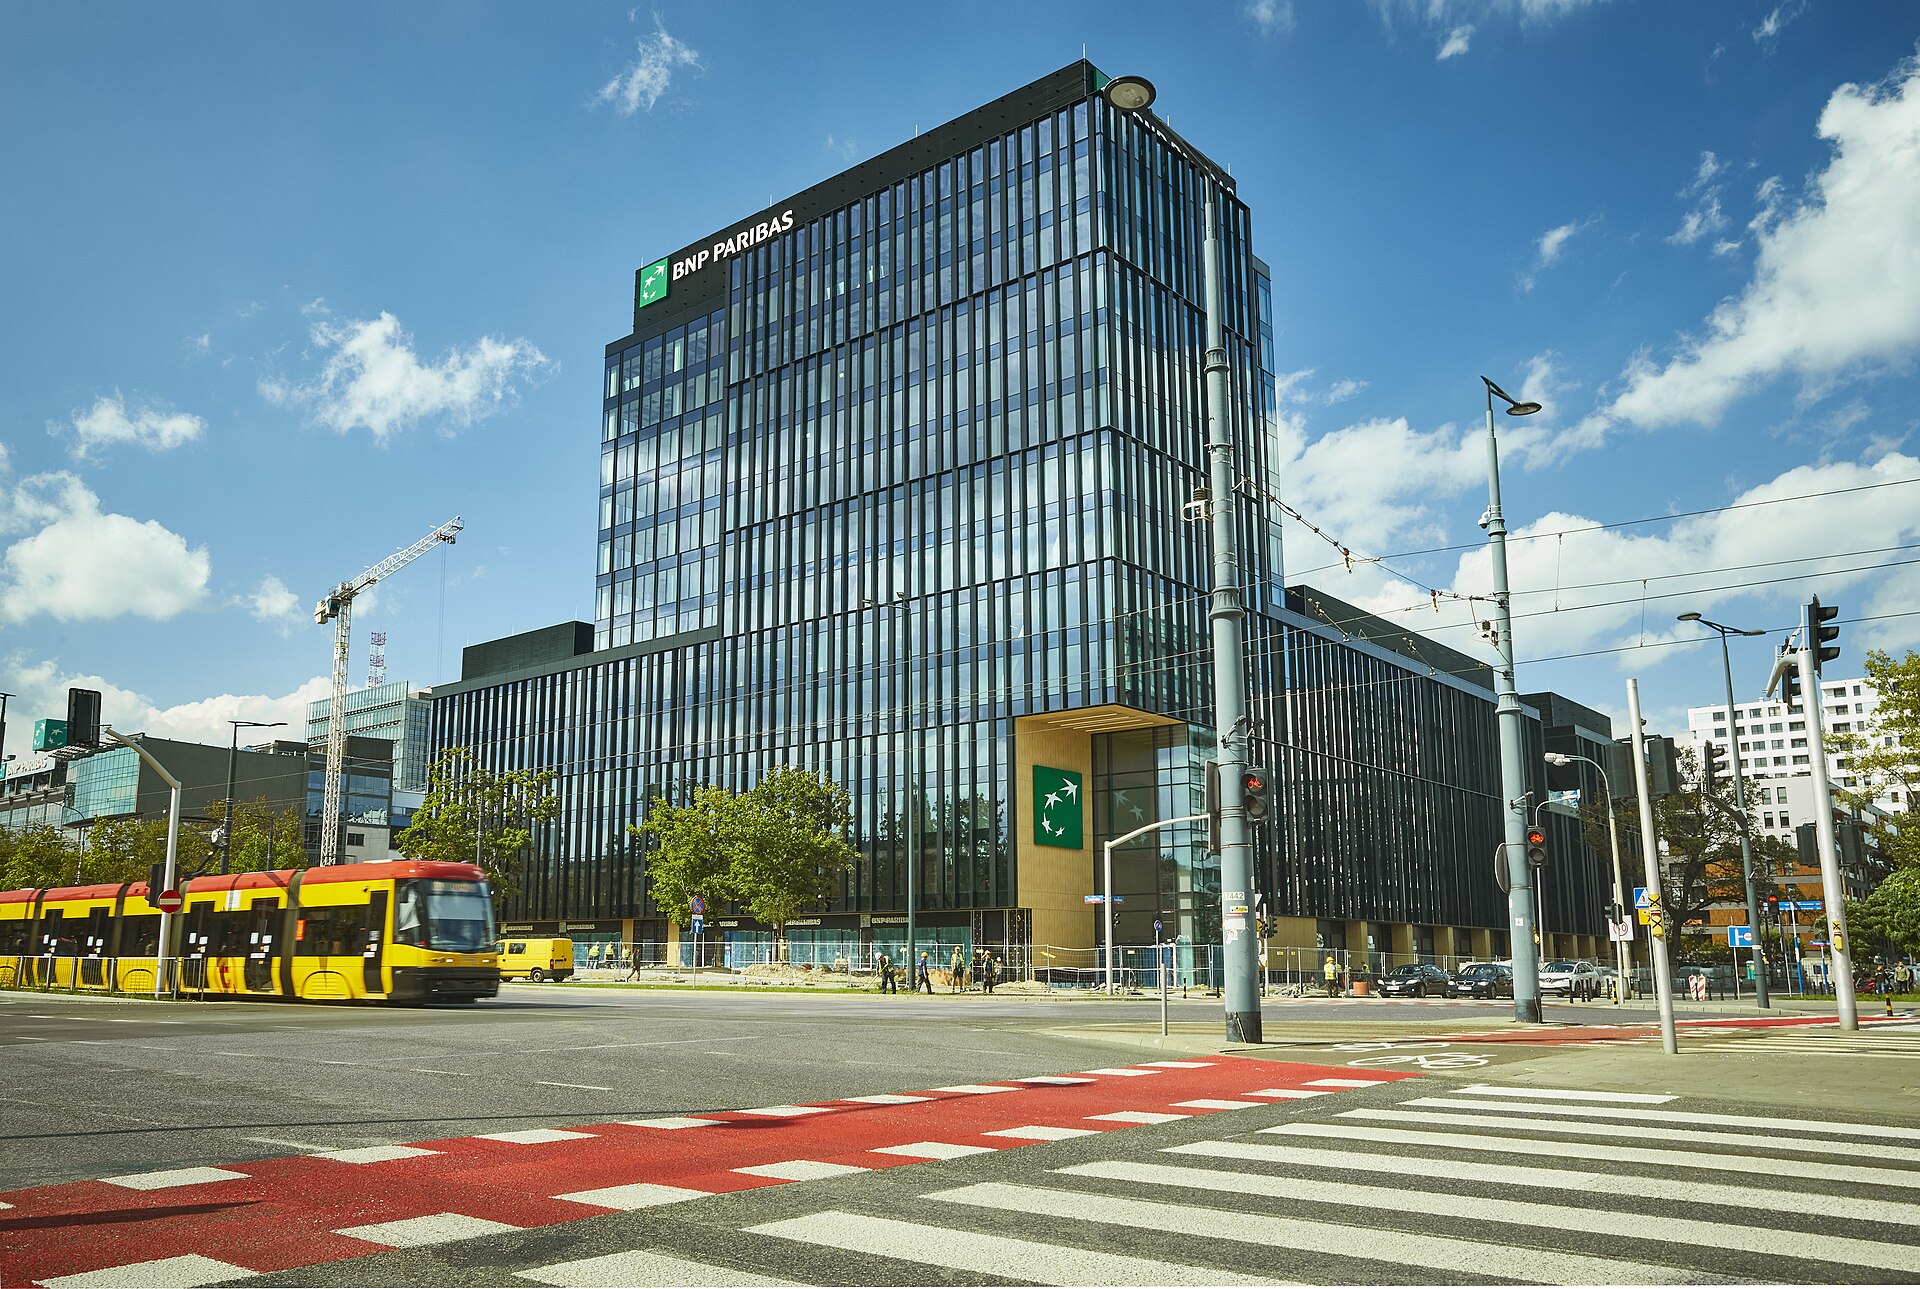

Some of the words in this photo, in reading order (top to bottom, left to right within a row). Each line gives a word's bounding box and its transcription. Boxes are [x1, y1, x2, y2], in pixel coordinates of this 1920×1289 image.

[672, 250, 709, 281] BNP
[713, 210, 794, 262] PARIBAS
[341, 647, 346, 655] 3
